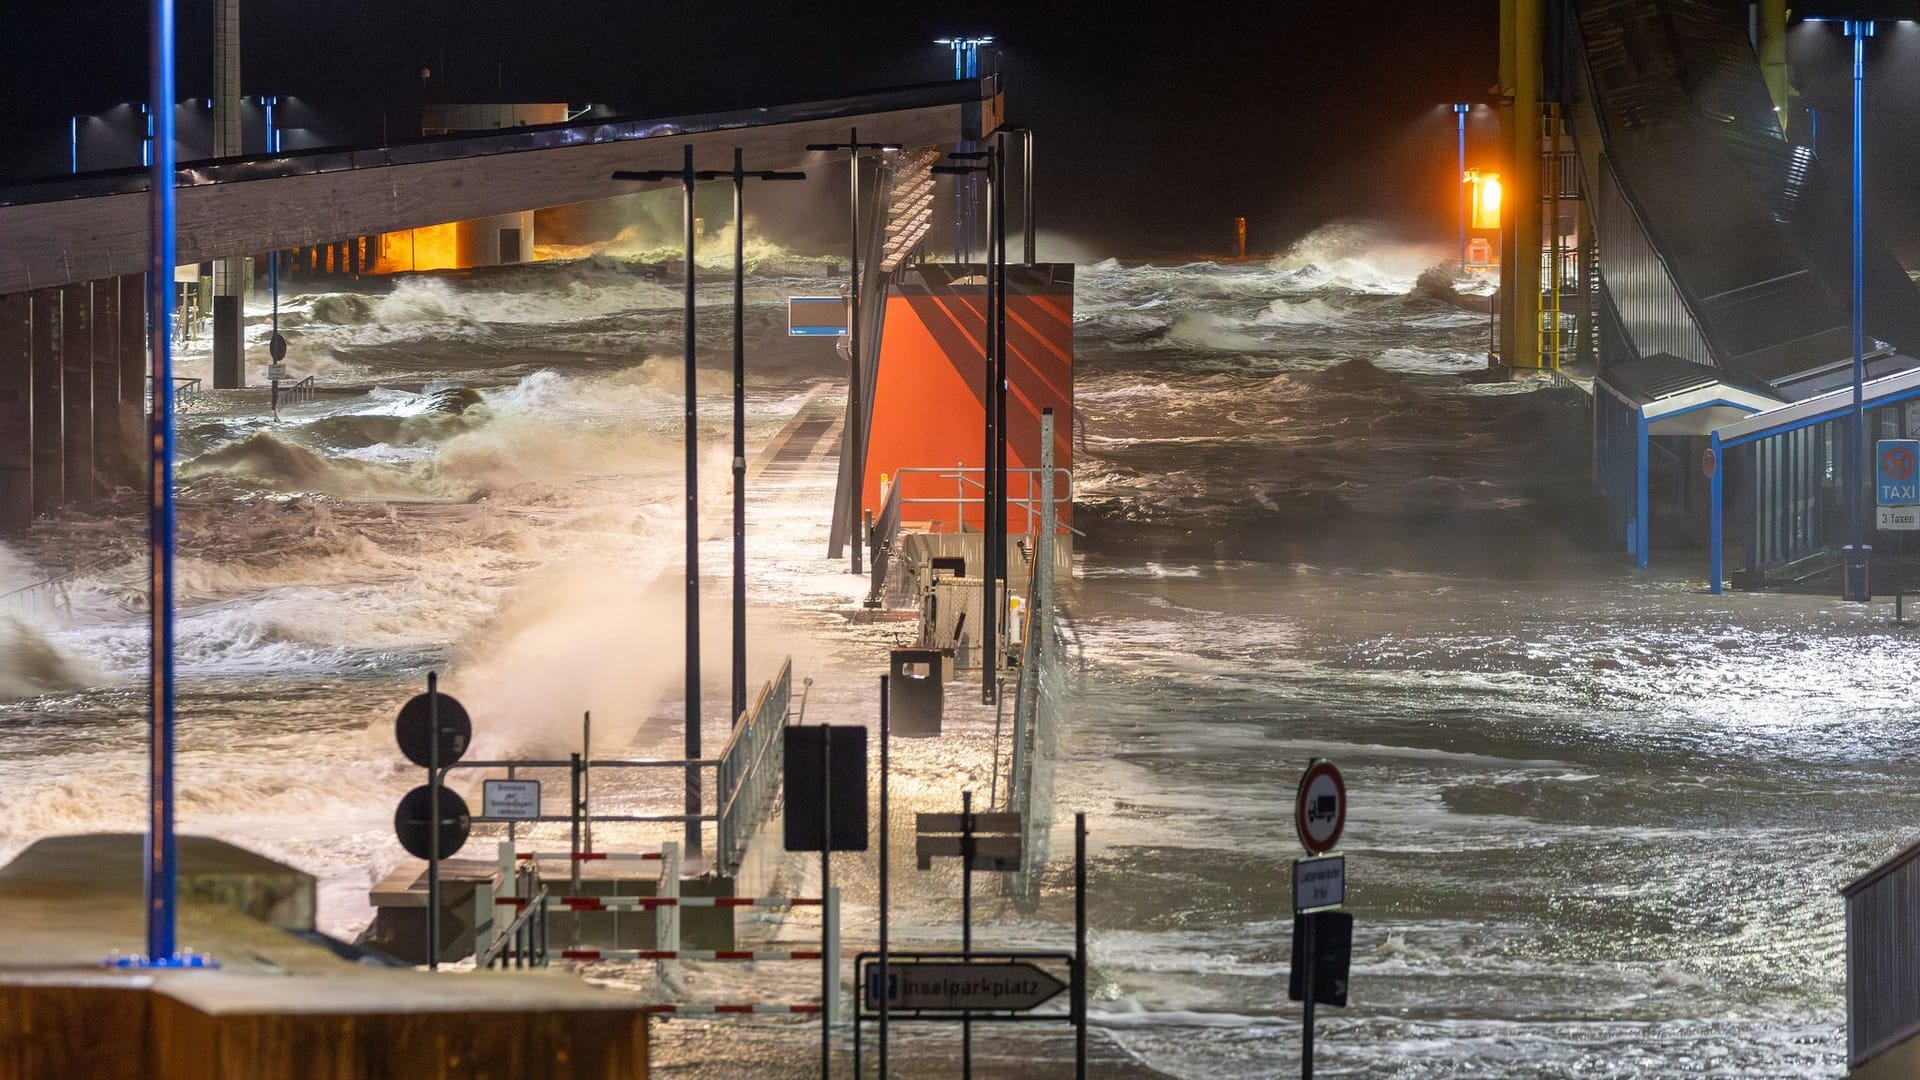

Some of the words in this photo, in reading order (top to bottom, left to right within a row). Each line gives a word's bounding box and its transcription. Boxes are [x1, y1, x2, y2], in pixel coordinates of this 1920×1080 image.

[1882, 485, 1915, 499] TAXI
[1882, 514, 1888, 524] 3
[1891, 513, 1914, 524] Taxen
